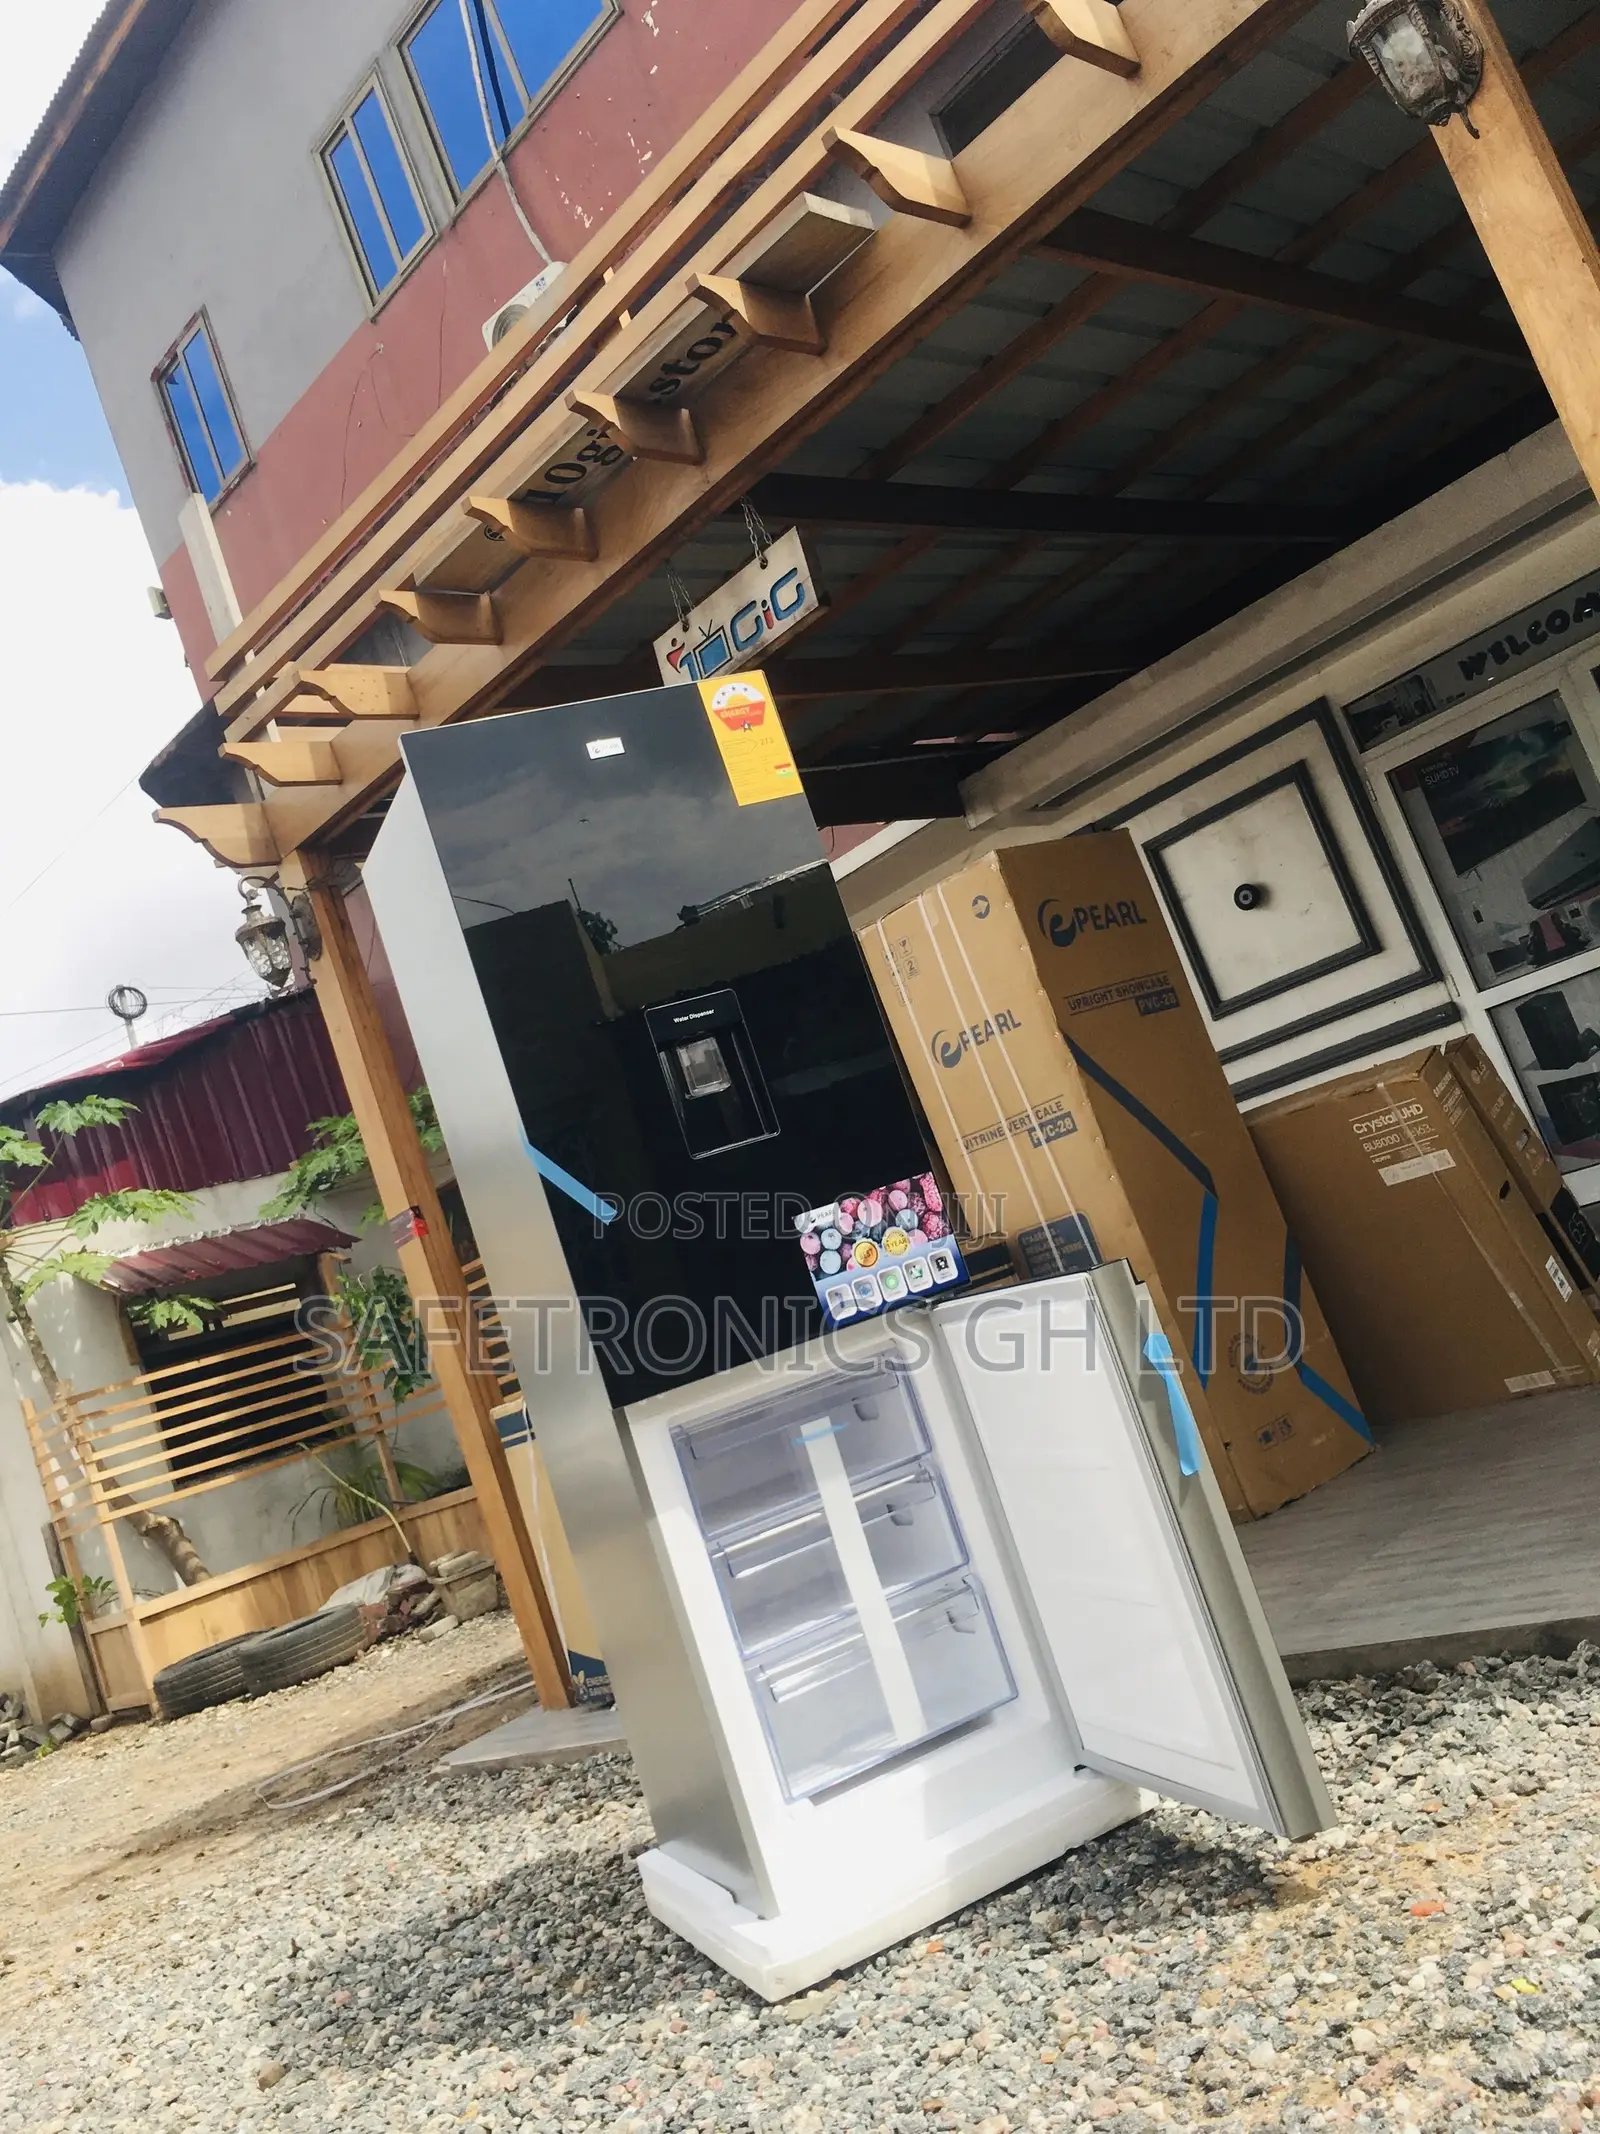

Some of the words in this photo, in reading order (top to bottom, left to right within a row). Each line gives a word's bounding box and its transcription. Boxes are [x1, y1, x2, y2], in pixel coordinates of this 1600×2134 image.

[1067, 989, 1115, 1011] UPRIGHT
[1116, 974, 1173, 998] SHOWCASE
[673, 1014, 689, 1023] Water
[689, 1008, 715, 1020] Dispenser
[963, 1125, 1004, 1150] VITRINE
[1007, 1100, 1064, 1132] VERTCALE
[1352, 1111, 1398, 1133] Crystal
[1363, 1133, 1400, 1152] BU8000
